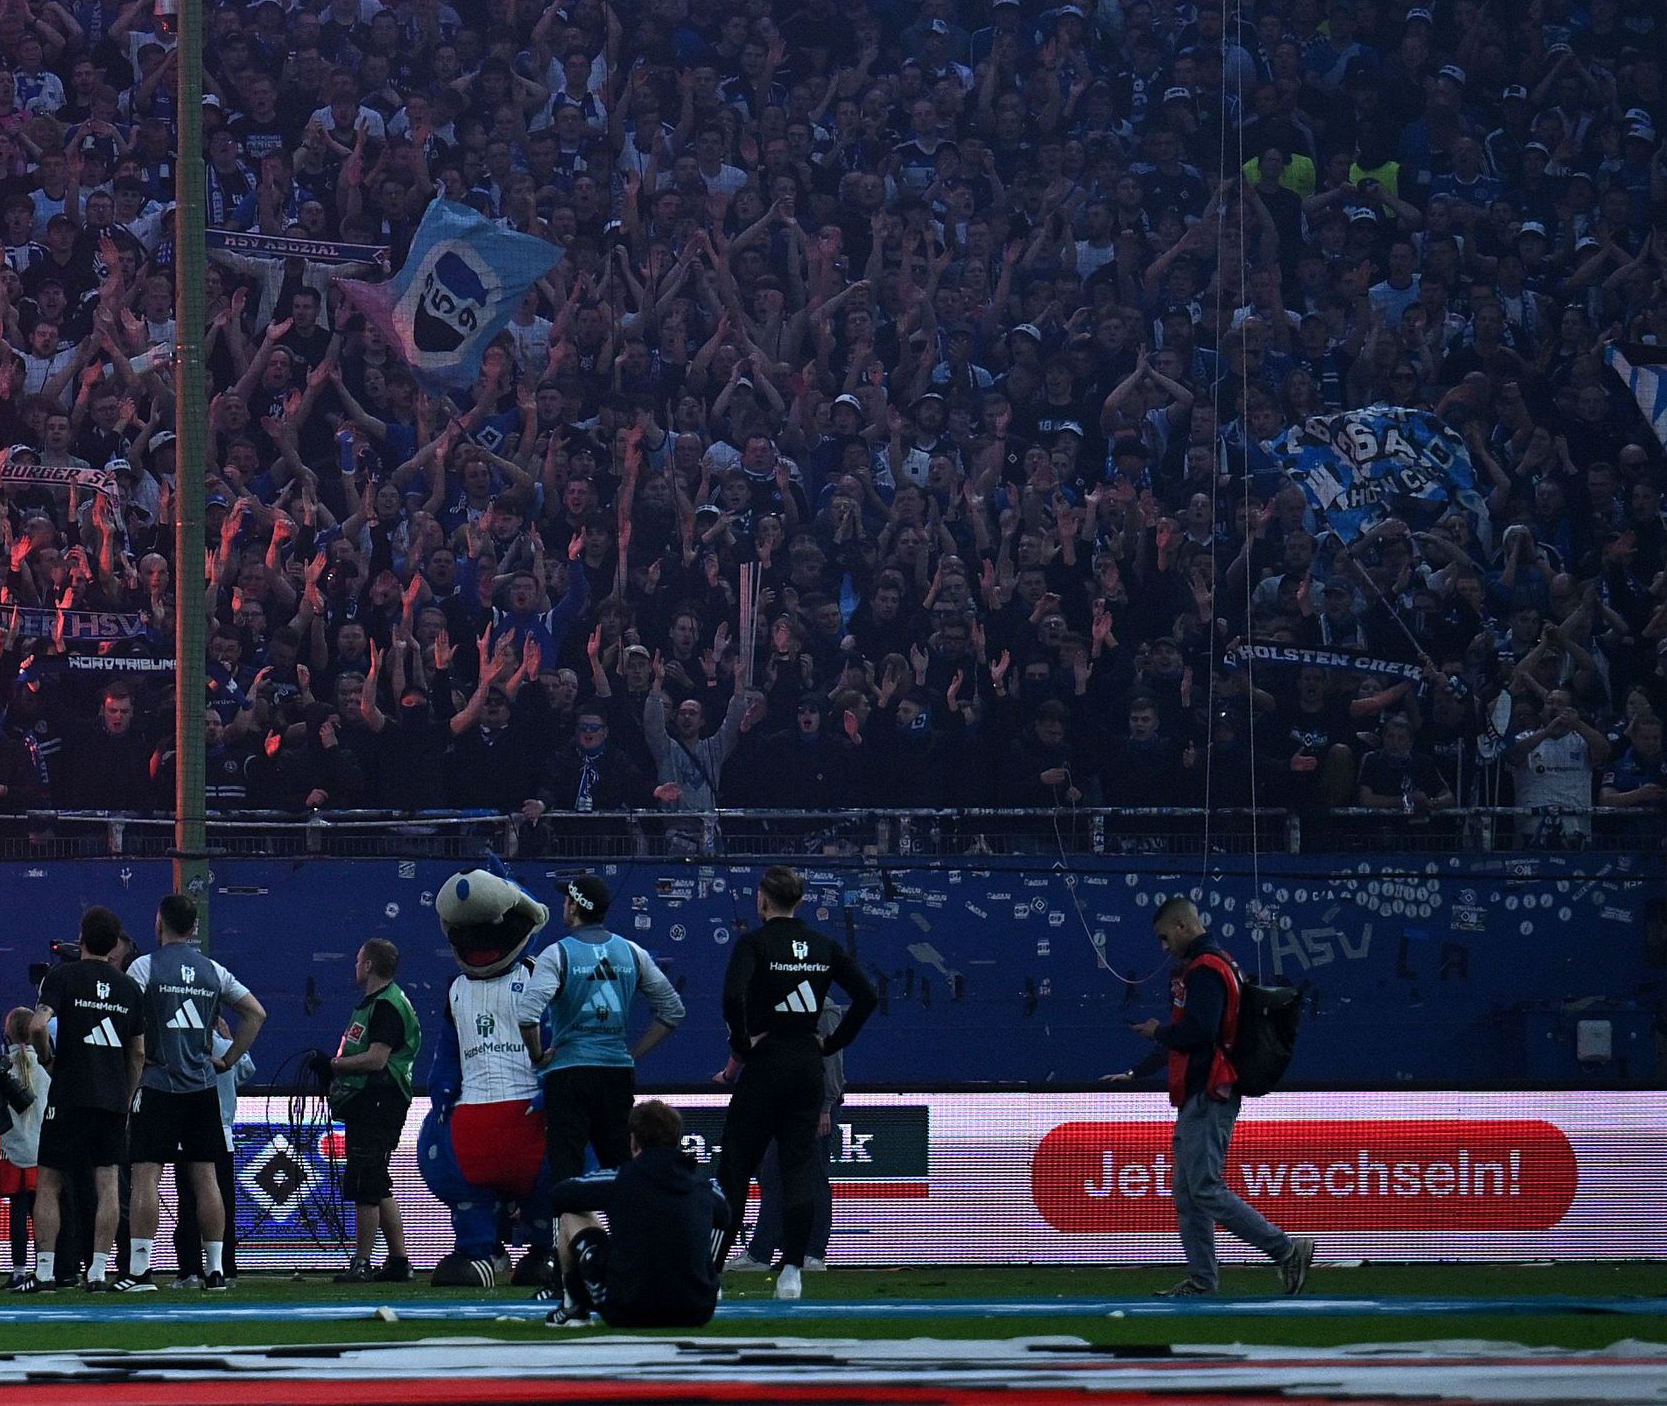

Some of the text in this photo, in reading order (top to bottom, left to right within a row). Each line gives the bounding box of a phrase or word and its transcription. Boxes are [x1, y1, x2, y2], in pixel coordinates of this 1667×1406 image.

[224, 235, 260, 248] HSV
[72, 612, 145, 637] HSV
[1239, 645, 1350, 668] HOLSTEN
[1270, 922, 1373, 976] HSV
[769, 961, 830, 973] HanseMerkur
[158, 984, 215, 998] HanseMerkur
[73, 997, 129, 1014] HanseMerkur
[1241, 1149, 1522, 1198] wechseln!
